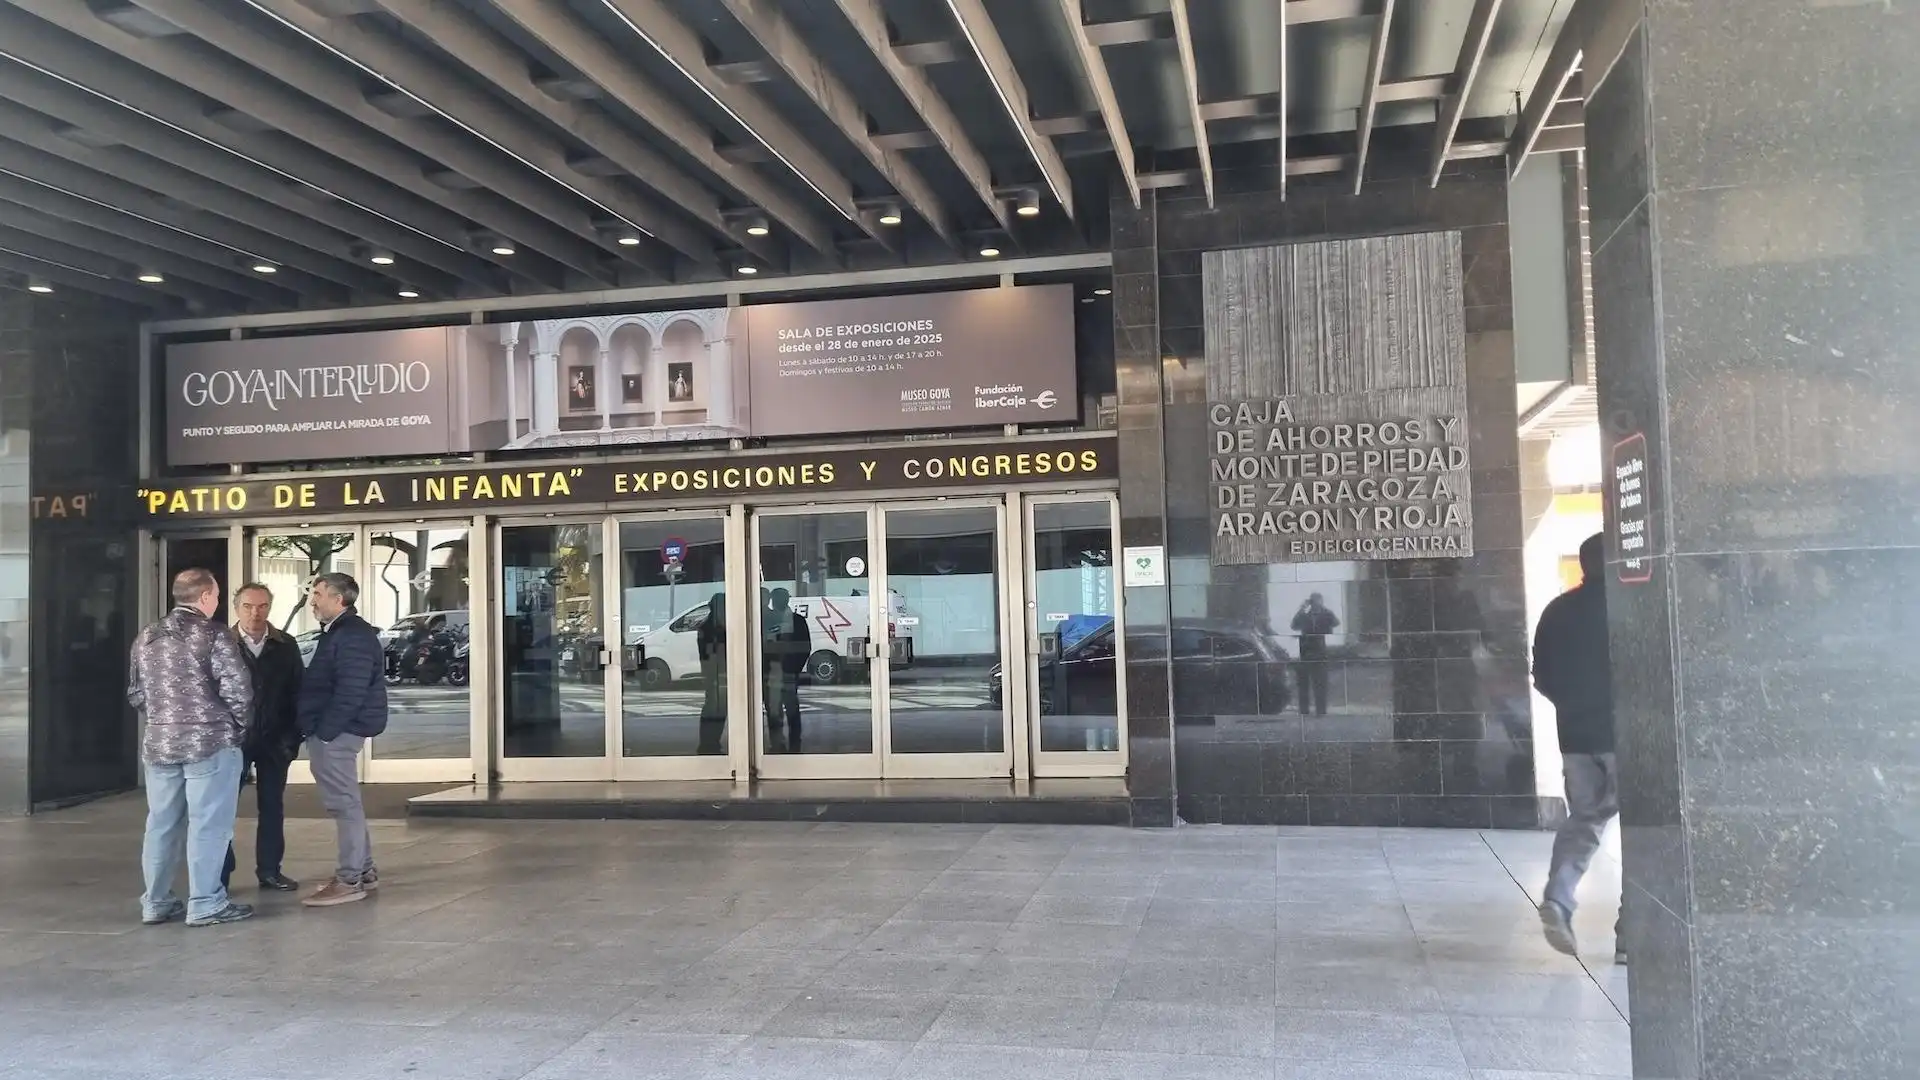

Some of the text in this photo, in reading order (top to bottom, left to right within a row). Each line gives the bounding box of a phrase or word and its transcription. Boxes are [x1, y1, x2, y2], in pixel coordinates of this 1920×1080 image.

[778, 319, 933, 340] SALA DE EXPOSICIONES
[778, 333, 943, 353] desde el 28 de enero de 2025
[778, 359, 801, 367] Lunes
[867, 354, 878, 362] 14
[894, 352, 905, 360] de
[906, 351, 916, 359] 17
[924, 350, 935, 358] 20
[779, 367, 817, 377] Domingos
[818, 368, 824, 376] y
[824, 366, 854, 374] festivos
[866, 364, 877, 372] 10
[885, 363, 895, 371] 14
[901, 388, 951, 400] MUSEO GOYA
[974, 384, 1024, 395] Fundación
[1210, 400, 1295, 426] CAJA
[183, 414, 431, 437] PUNTO Y SEGUIDO PARA AMPLIAR LA MIRADA DE GOYA
[1216, 415, 1458, 454] DE AHORROS Y
[614, 450, 1099, 494] EXPOSICIONES Y CONGRESOS
[1211, 446, 1469, 482] MONTE DE PIEDAD
[274, 483, 316, 509] DE
[344, 481, 386, 506] LA
[1217, 484, 1256, 509] DE
[1216, 508, 1343, 537] ARAGON
[1348, 507, 1368, 531] Y
[1290, 535, 1470, 555] EDIFICIO CENTRAL
